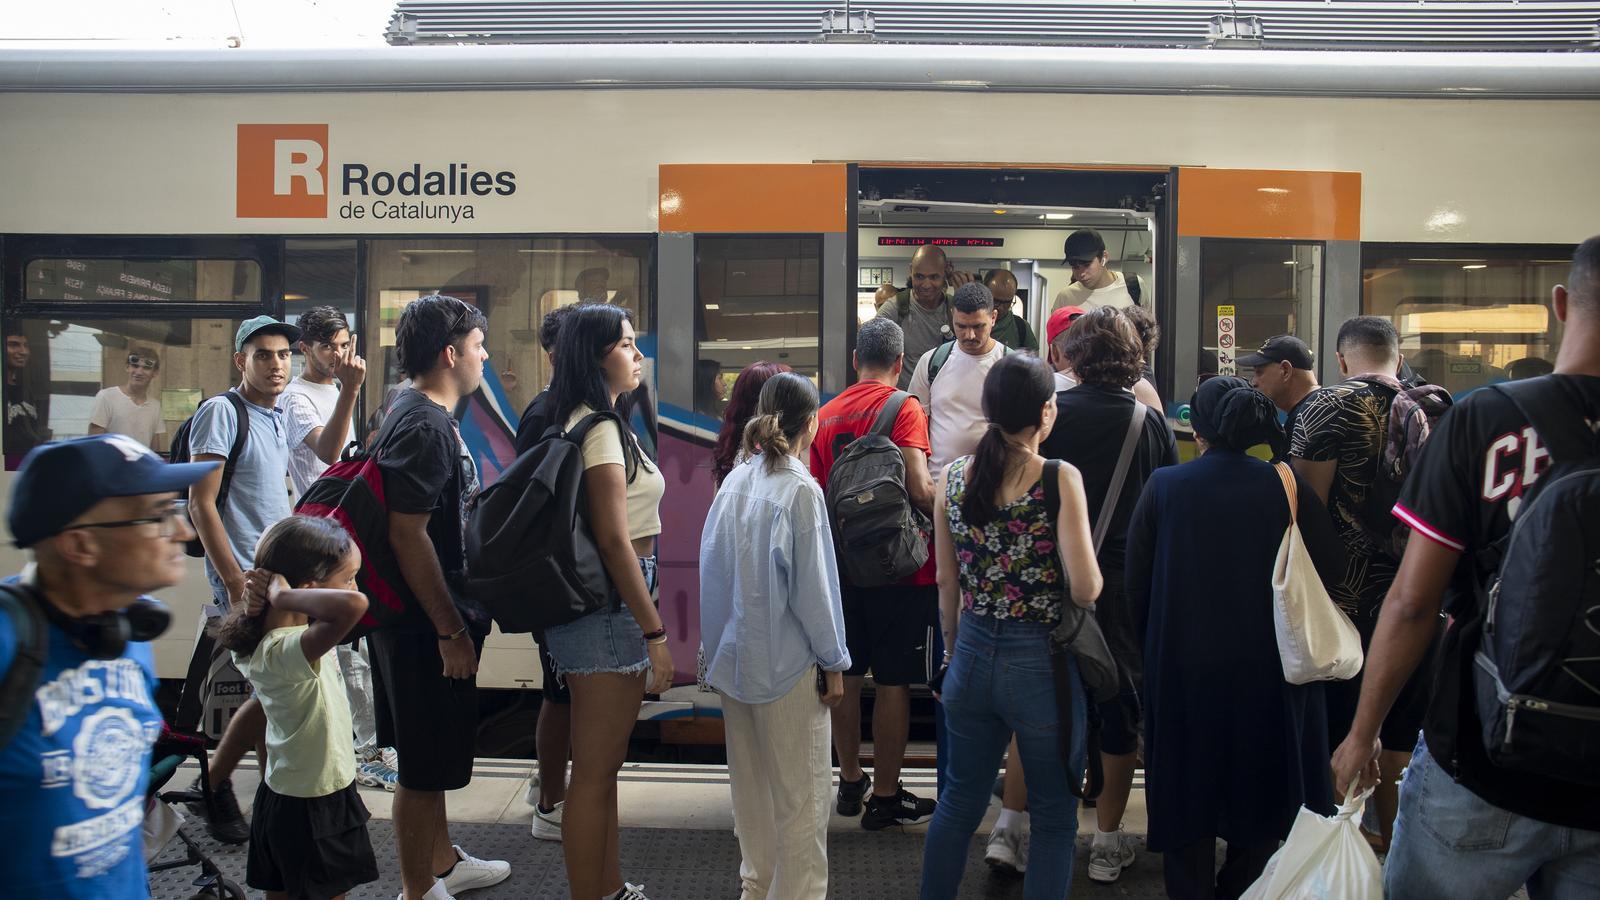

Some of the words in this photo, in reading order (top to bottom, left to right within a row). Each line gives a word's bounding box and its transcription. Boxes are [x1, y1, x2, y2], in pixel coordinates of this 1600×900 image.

[273, 139, 325, 195] R
[342, 163, 517, 196] Rodalies
[339, 201, 365, 219] de
[371, 201, 475, 223] Catalunya
[216, 683, 241, 694] Foot
